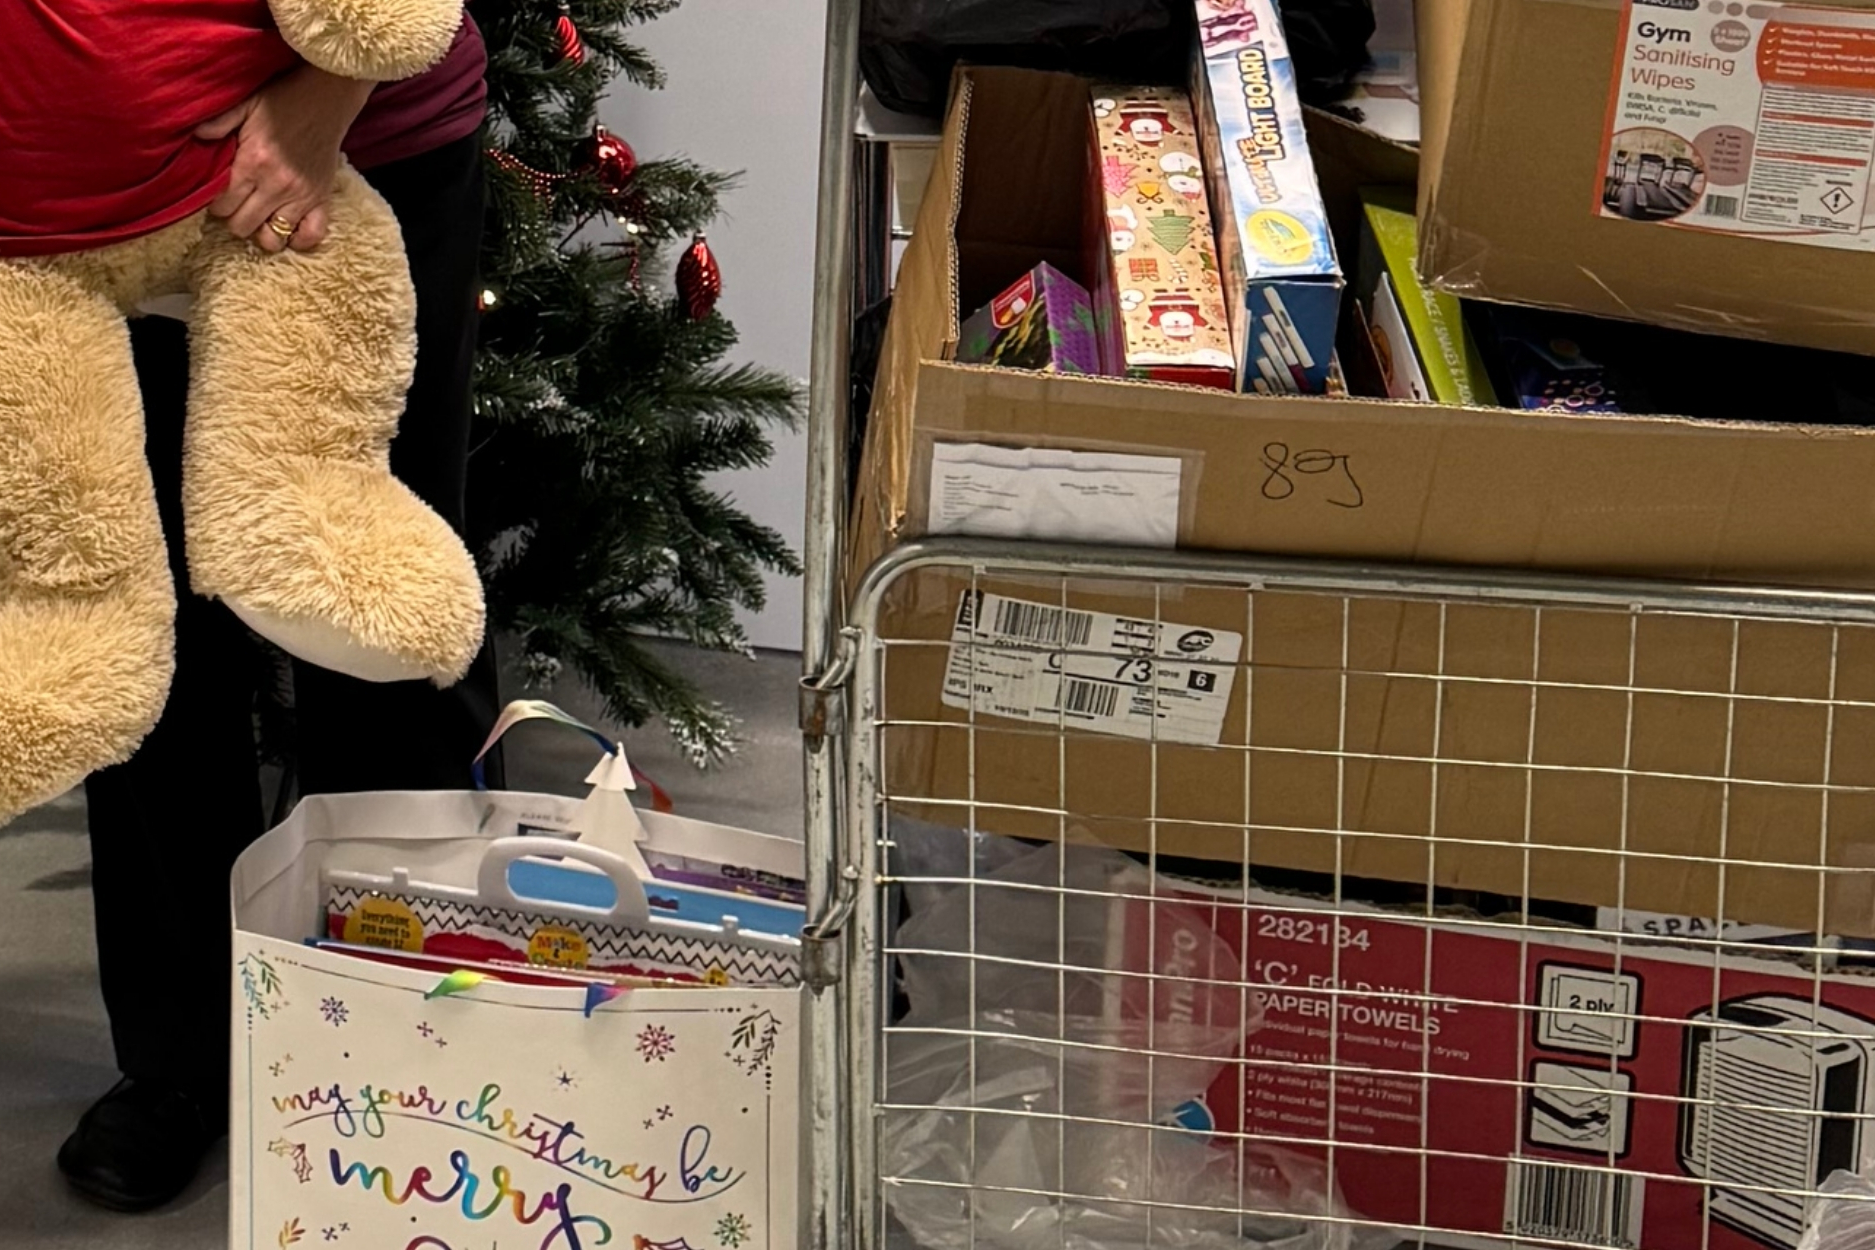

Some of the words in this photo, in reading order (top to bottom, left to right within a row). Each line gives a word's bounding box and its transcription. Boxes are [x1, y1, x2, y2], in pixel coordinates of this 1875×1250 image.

[1637, 21, 1691, 44] Gym
[1633, 44, 1736, 77] Sanitising
[1238, 48, 1275, 109] BOARD
[1631, 67, 1696, 91] Wipes
[1624, 112, 1642, 121] and
[1644, 112, 1667, 124] Fungi
[1250, 110, 1286, 160] LIGHT
[1114, 657, 1153, 683] 73
[1195, 673, 1208, 688] 6
[361, 909, 410, 928] Everything
[1643, 916, 1731, 935] SPA
[360, 923, 377, 933] you
[378, 926, 399, 935] need
[400, 928, 411, 939] to
[536, 936, 582, 950] Make
[1255, 991, 1331, 1019] PAPER
[1339, 1003, 1441, 1035] TOWELS
[1569, 994, 1581, 1009] 2
[1585, 996, 1615, 1013] ply
[1343, 1031, 1381, 1046] towels
[1383, 1037, 1399, 1049] for
[1433, 1045, 1470, 1061] drying
[1257, 1071, 1274, 1083] ply
[272, 1084, 355, 1138] may
[361, 1084, 447, 1138] your
[455, 1083, 668, 1200] christmas
[678, 1125, 734, 1193] be
[329, 1148, 612, 1250] merry
